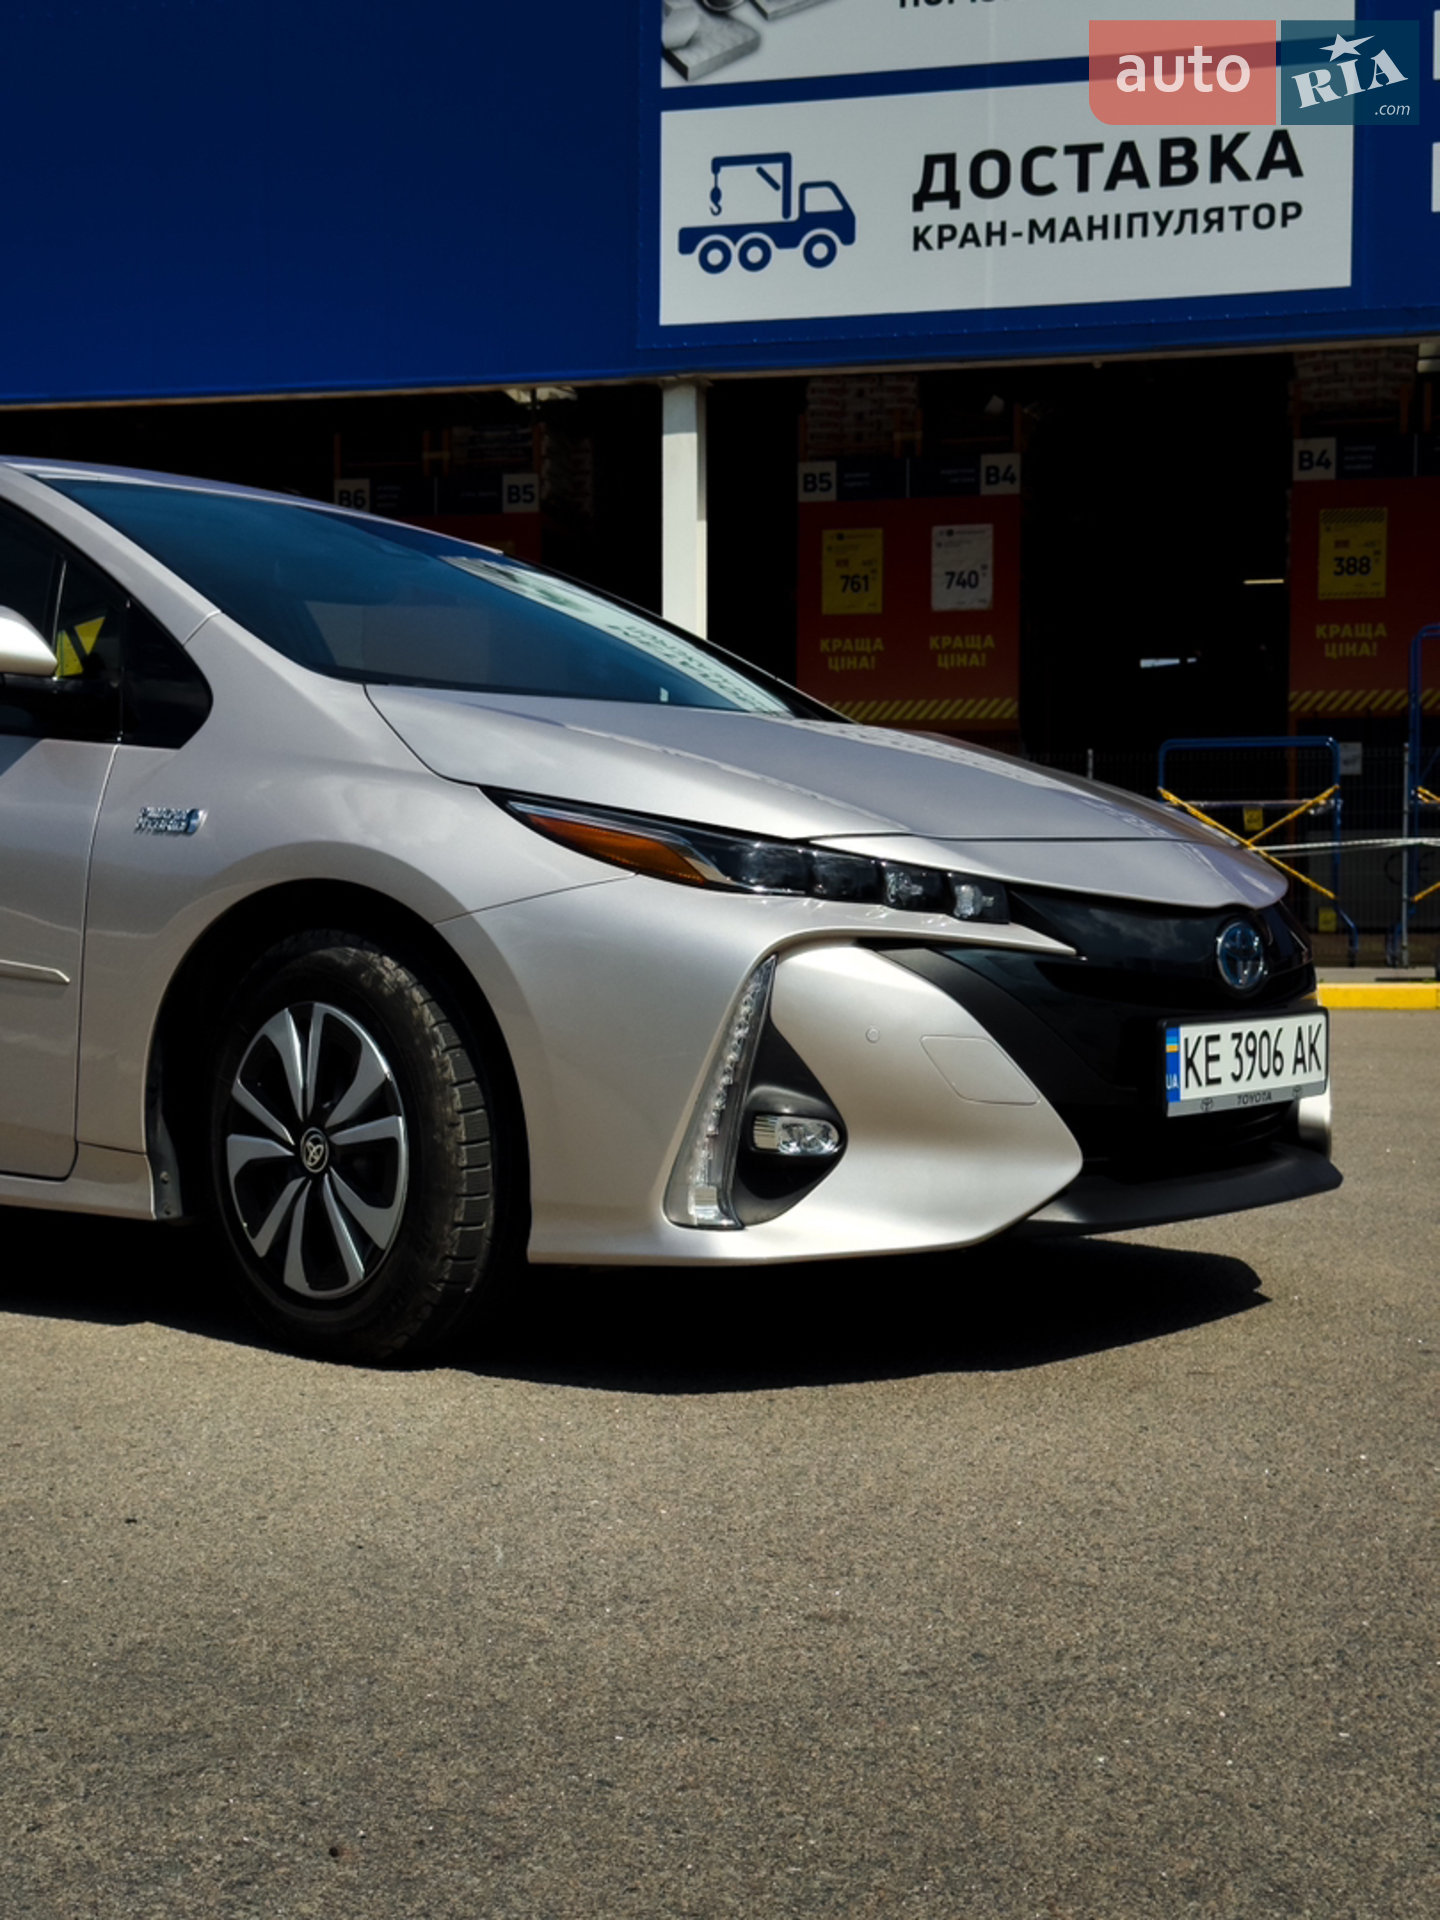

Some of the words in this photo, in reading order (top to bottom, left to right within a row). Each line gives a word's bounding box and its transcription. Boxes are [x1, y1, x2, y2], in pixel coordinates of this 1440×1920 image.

[912, 129, 1304, 212] ДОСТАВКА
[912, 201, 1303, 252] КРАН-МАНІПУЛЯТОР
[1333, 555, 1371, 576] 388
[840, 574, 869, 594] 761
[944, 570, 979, 590] 740
[1315, 622, 1387, 640] КРАЩА
[819, 637, 885, 654] КРАЩА
[929, 634, 995, 652] КРАЩА
[1324, 641, 1377, 660] ЦІНА!
[828, 655, 876, 672] ЦІНА!
[937, 652, 987, 669] ЦІНА!
[1184, 1034, 1222, 1089] KE
[1230, 1027, 1285, 1082] 3906
[1292, 1023, 1322, 1076] AK
[1166, 1073, 1179, 1090] UA
[1236, 1091, 1272, 1105] TOYOTA
